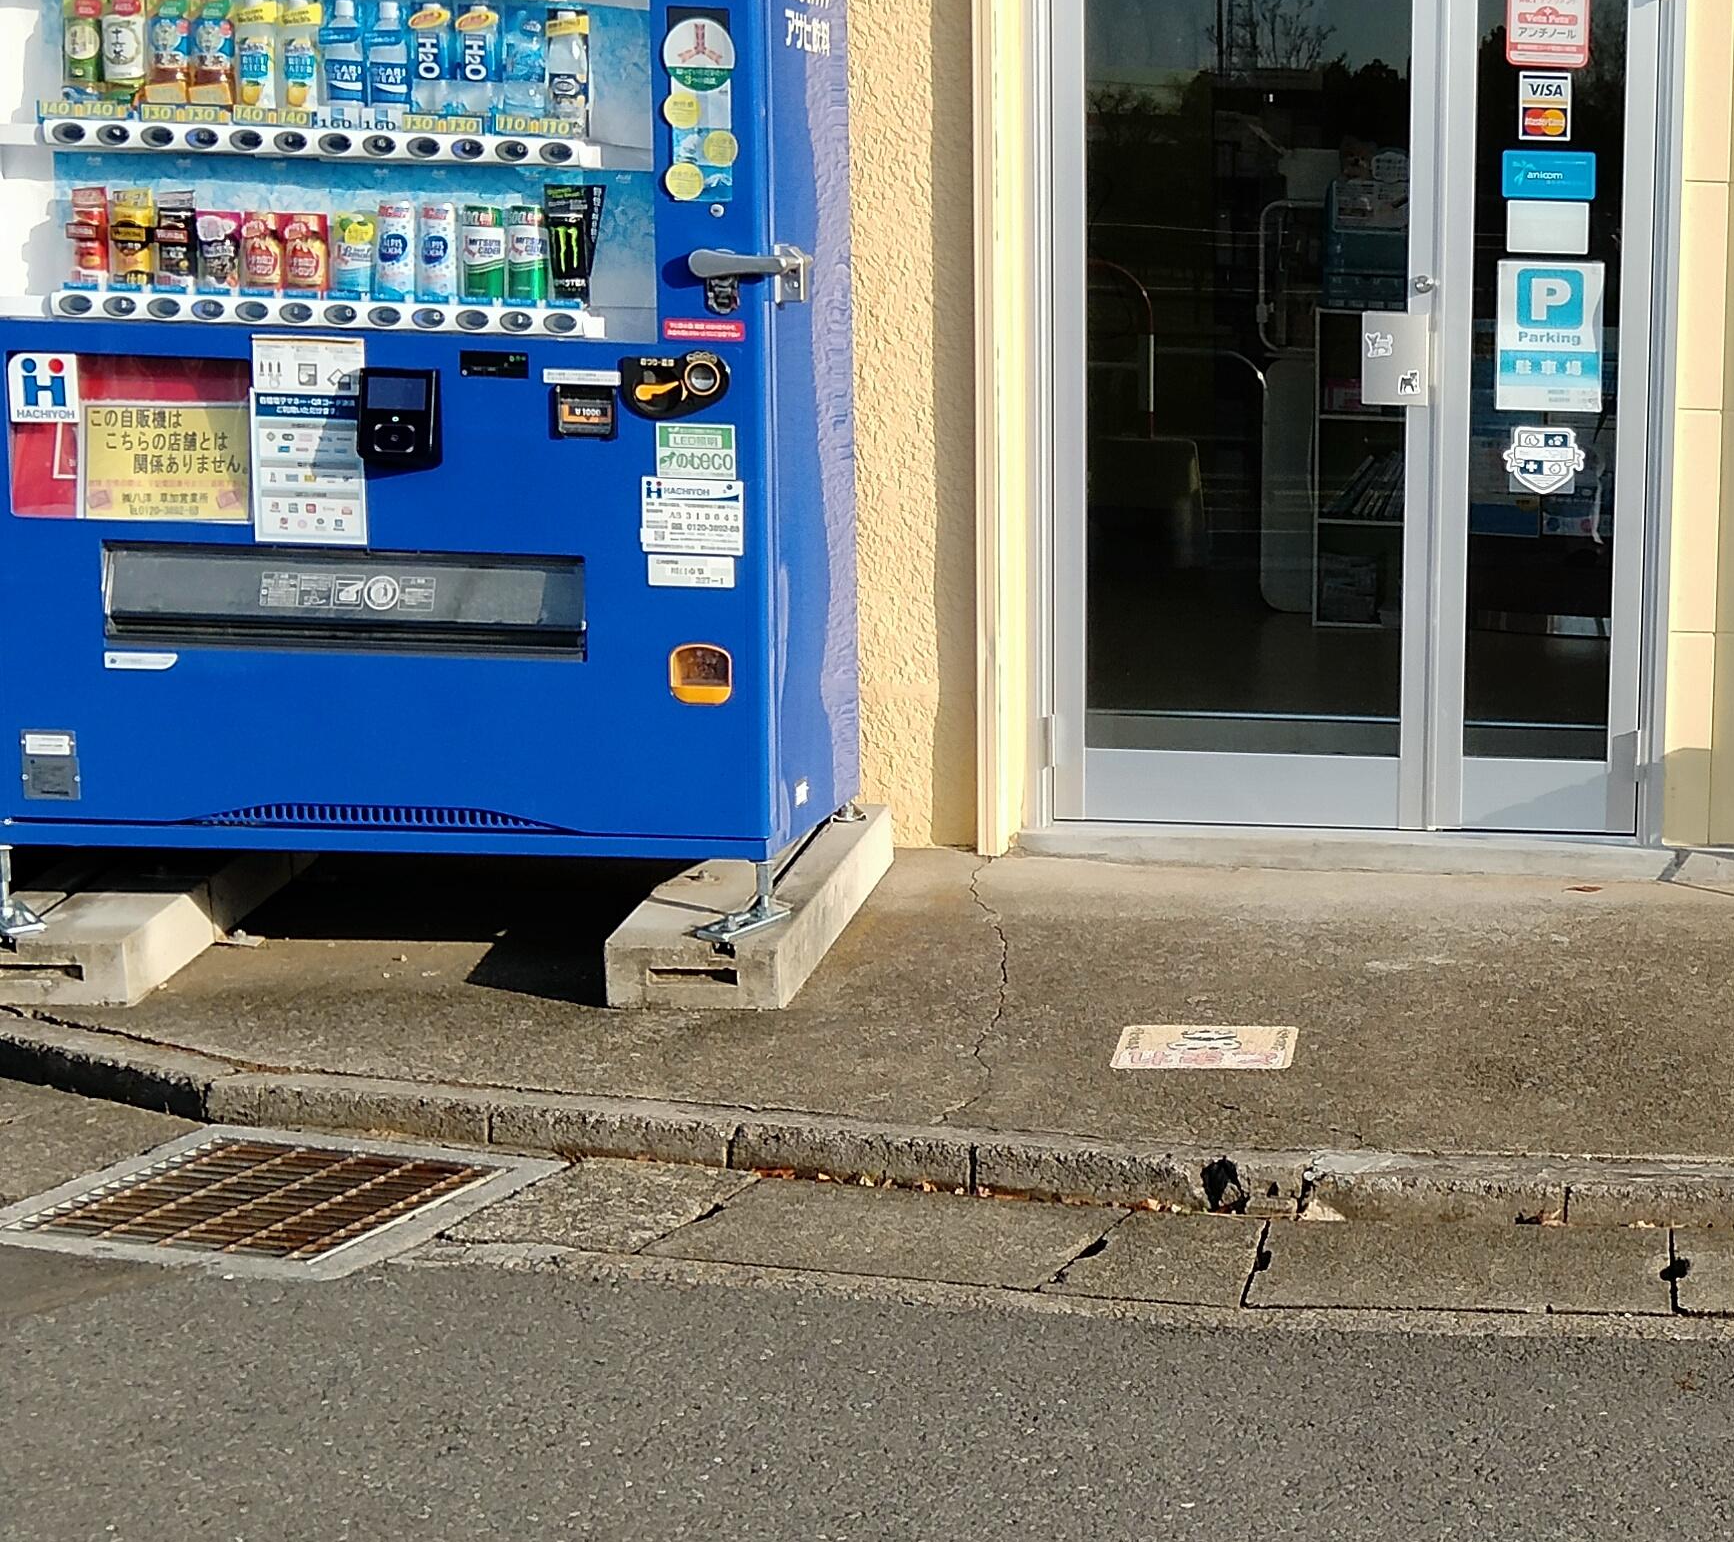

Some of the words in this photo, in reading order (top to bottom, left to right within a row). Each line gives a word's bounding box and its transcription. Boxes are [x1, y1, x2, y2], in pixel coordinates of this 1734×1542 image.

[784, 9, 832, 57] アサヒ飲料
[1518, 26, 1577, 40] アンチノール
[1529, 83, 1563, 98] VISA
[1531, 277, 1571, 321] P
[1518, 331, 1581, 347] Parking
[17, 409, 75, 420] HACHIYOH
[91, 410, 183, 428] この自販機は
[105, 432, 229, 452] こちらの店舗とは
[133, 454, 249, 475] 関係ありません。
